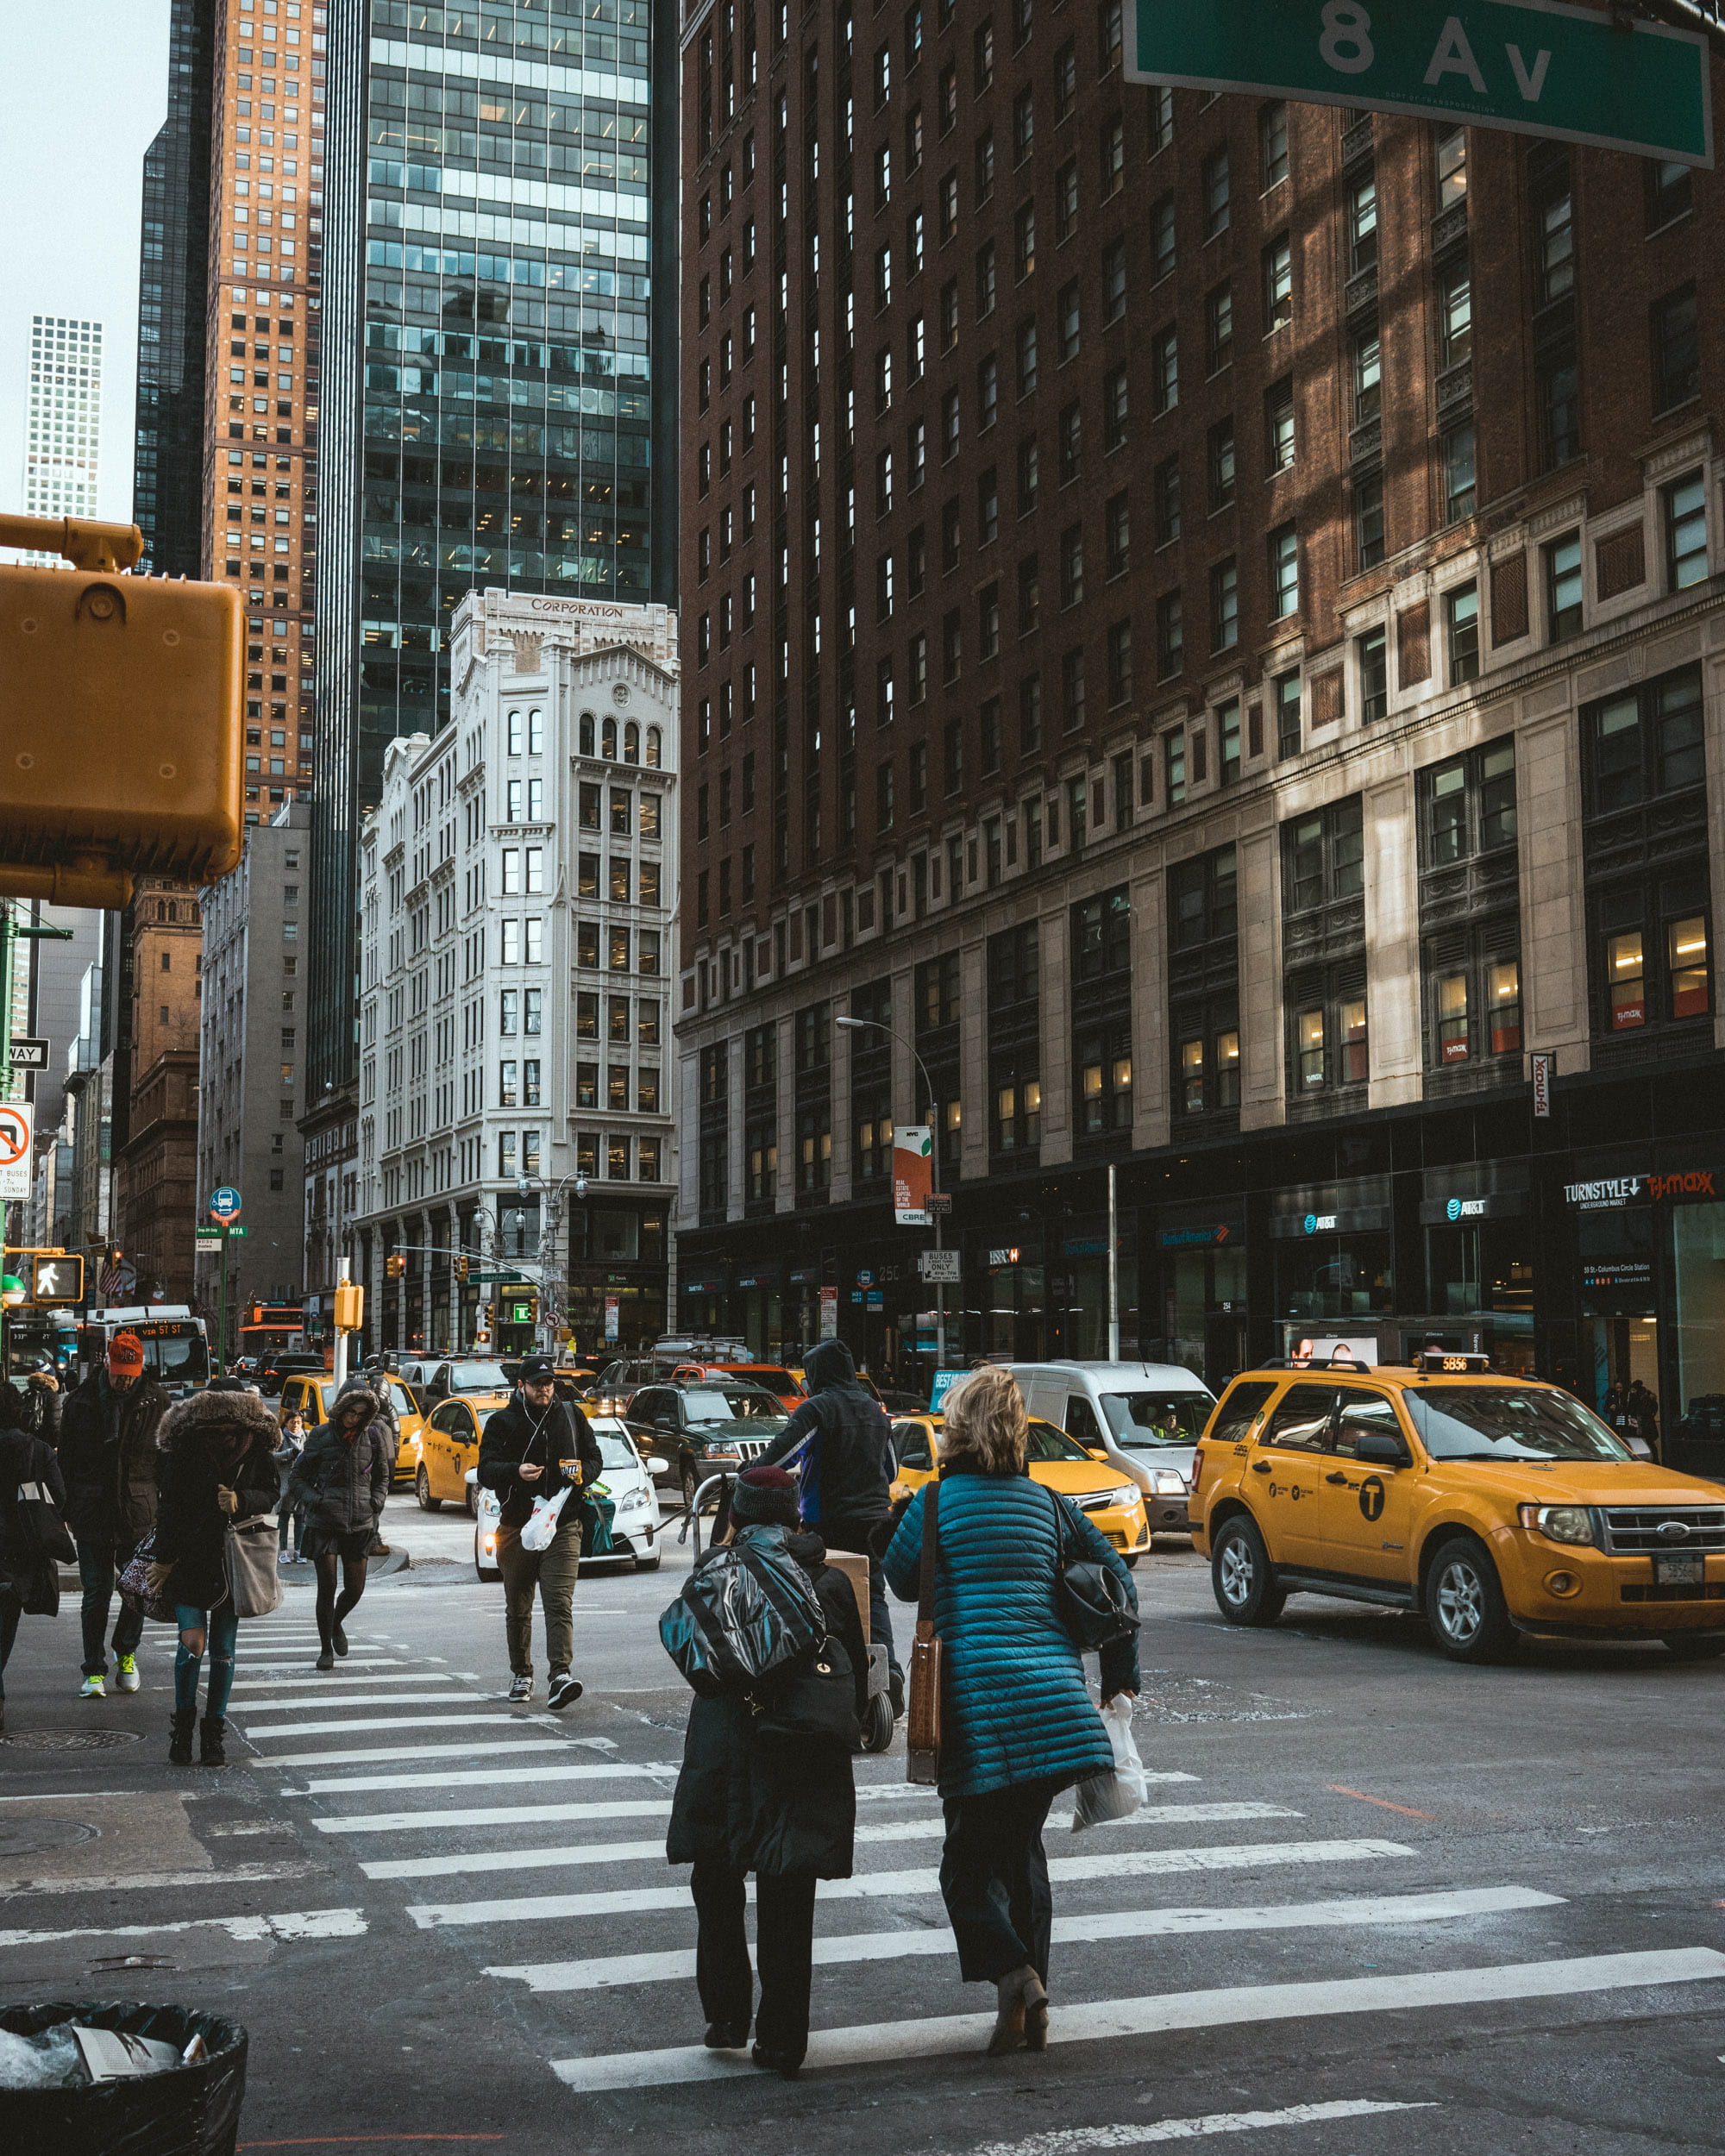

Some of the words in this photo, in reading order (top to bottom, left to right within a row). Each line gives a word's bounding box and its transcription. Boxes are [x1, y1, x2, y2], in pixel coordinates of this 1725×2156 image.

[1319, 0, 1374, 74] 8
[1421, 96, 1496, 113] TRANSPORTATION
[531, 599, 623, 618] CORPORATION
[1563, 1178, 1630, 1203] TURNSTYLE
[1461, 1200, 1485, 1216] AT&T
[1579, 1200, 1609, 1210] UNDERGROUND
[1609, 1198, 1626, 1207] MARKET
[1315, 1215, 1336, 1230] AT&T
[989, 1249, 1010, 1265] HSBC
[159, 1325, 168, 1334] 57
[171, 1324, 181, 1333] ST
[1442, 1356, 1467, 1371] 5B56
[936, 1374, 951, 1388] BEST
[1366, 1485, 1379, 1515] T
